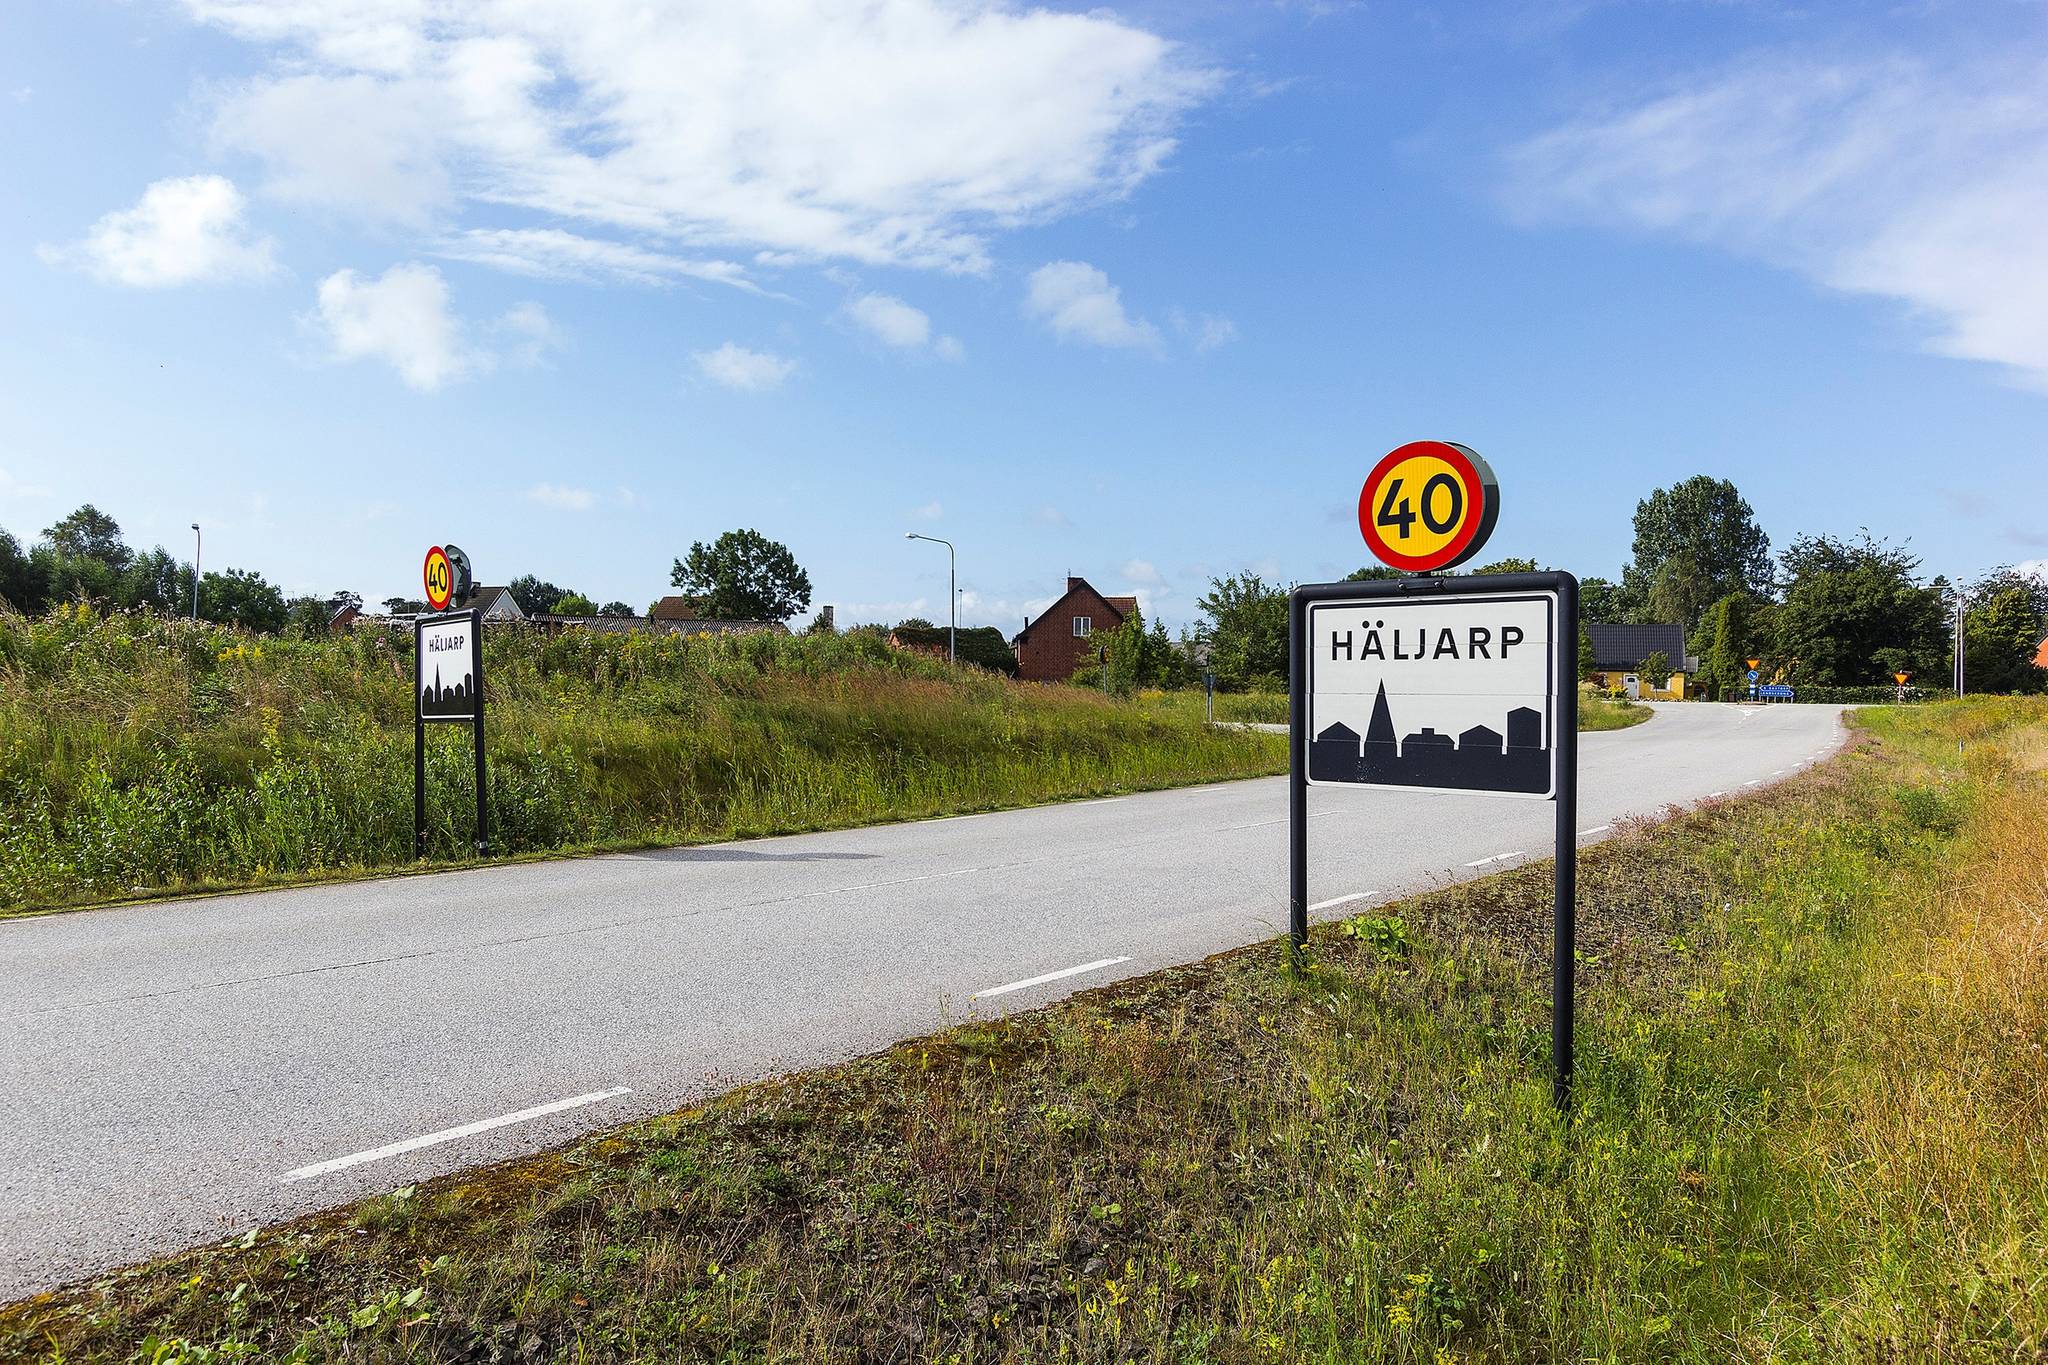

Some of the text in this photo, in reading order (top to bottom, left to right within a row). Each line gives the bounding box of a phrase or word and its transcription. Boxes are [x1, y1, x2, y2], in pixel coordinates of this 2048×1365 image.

[1377, 473, 1463, 539] 40
[428, 562, 448, 594] 40
[429, 635, 465, 653] HÄLJARP
[1331, 620, 1524, 661] HÄLJARP
